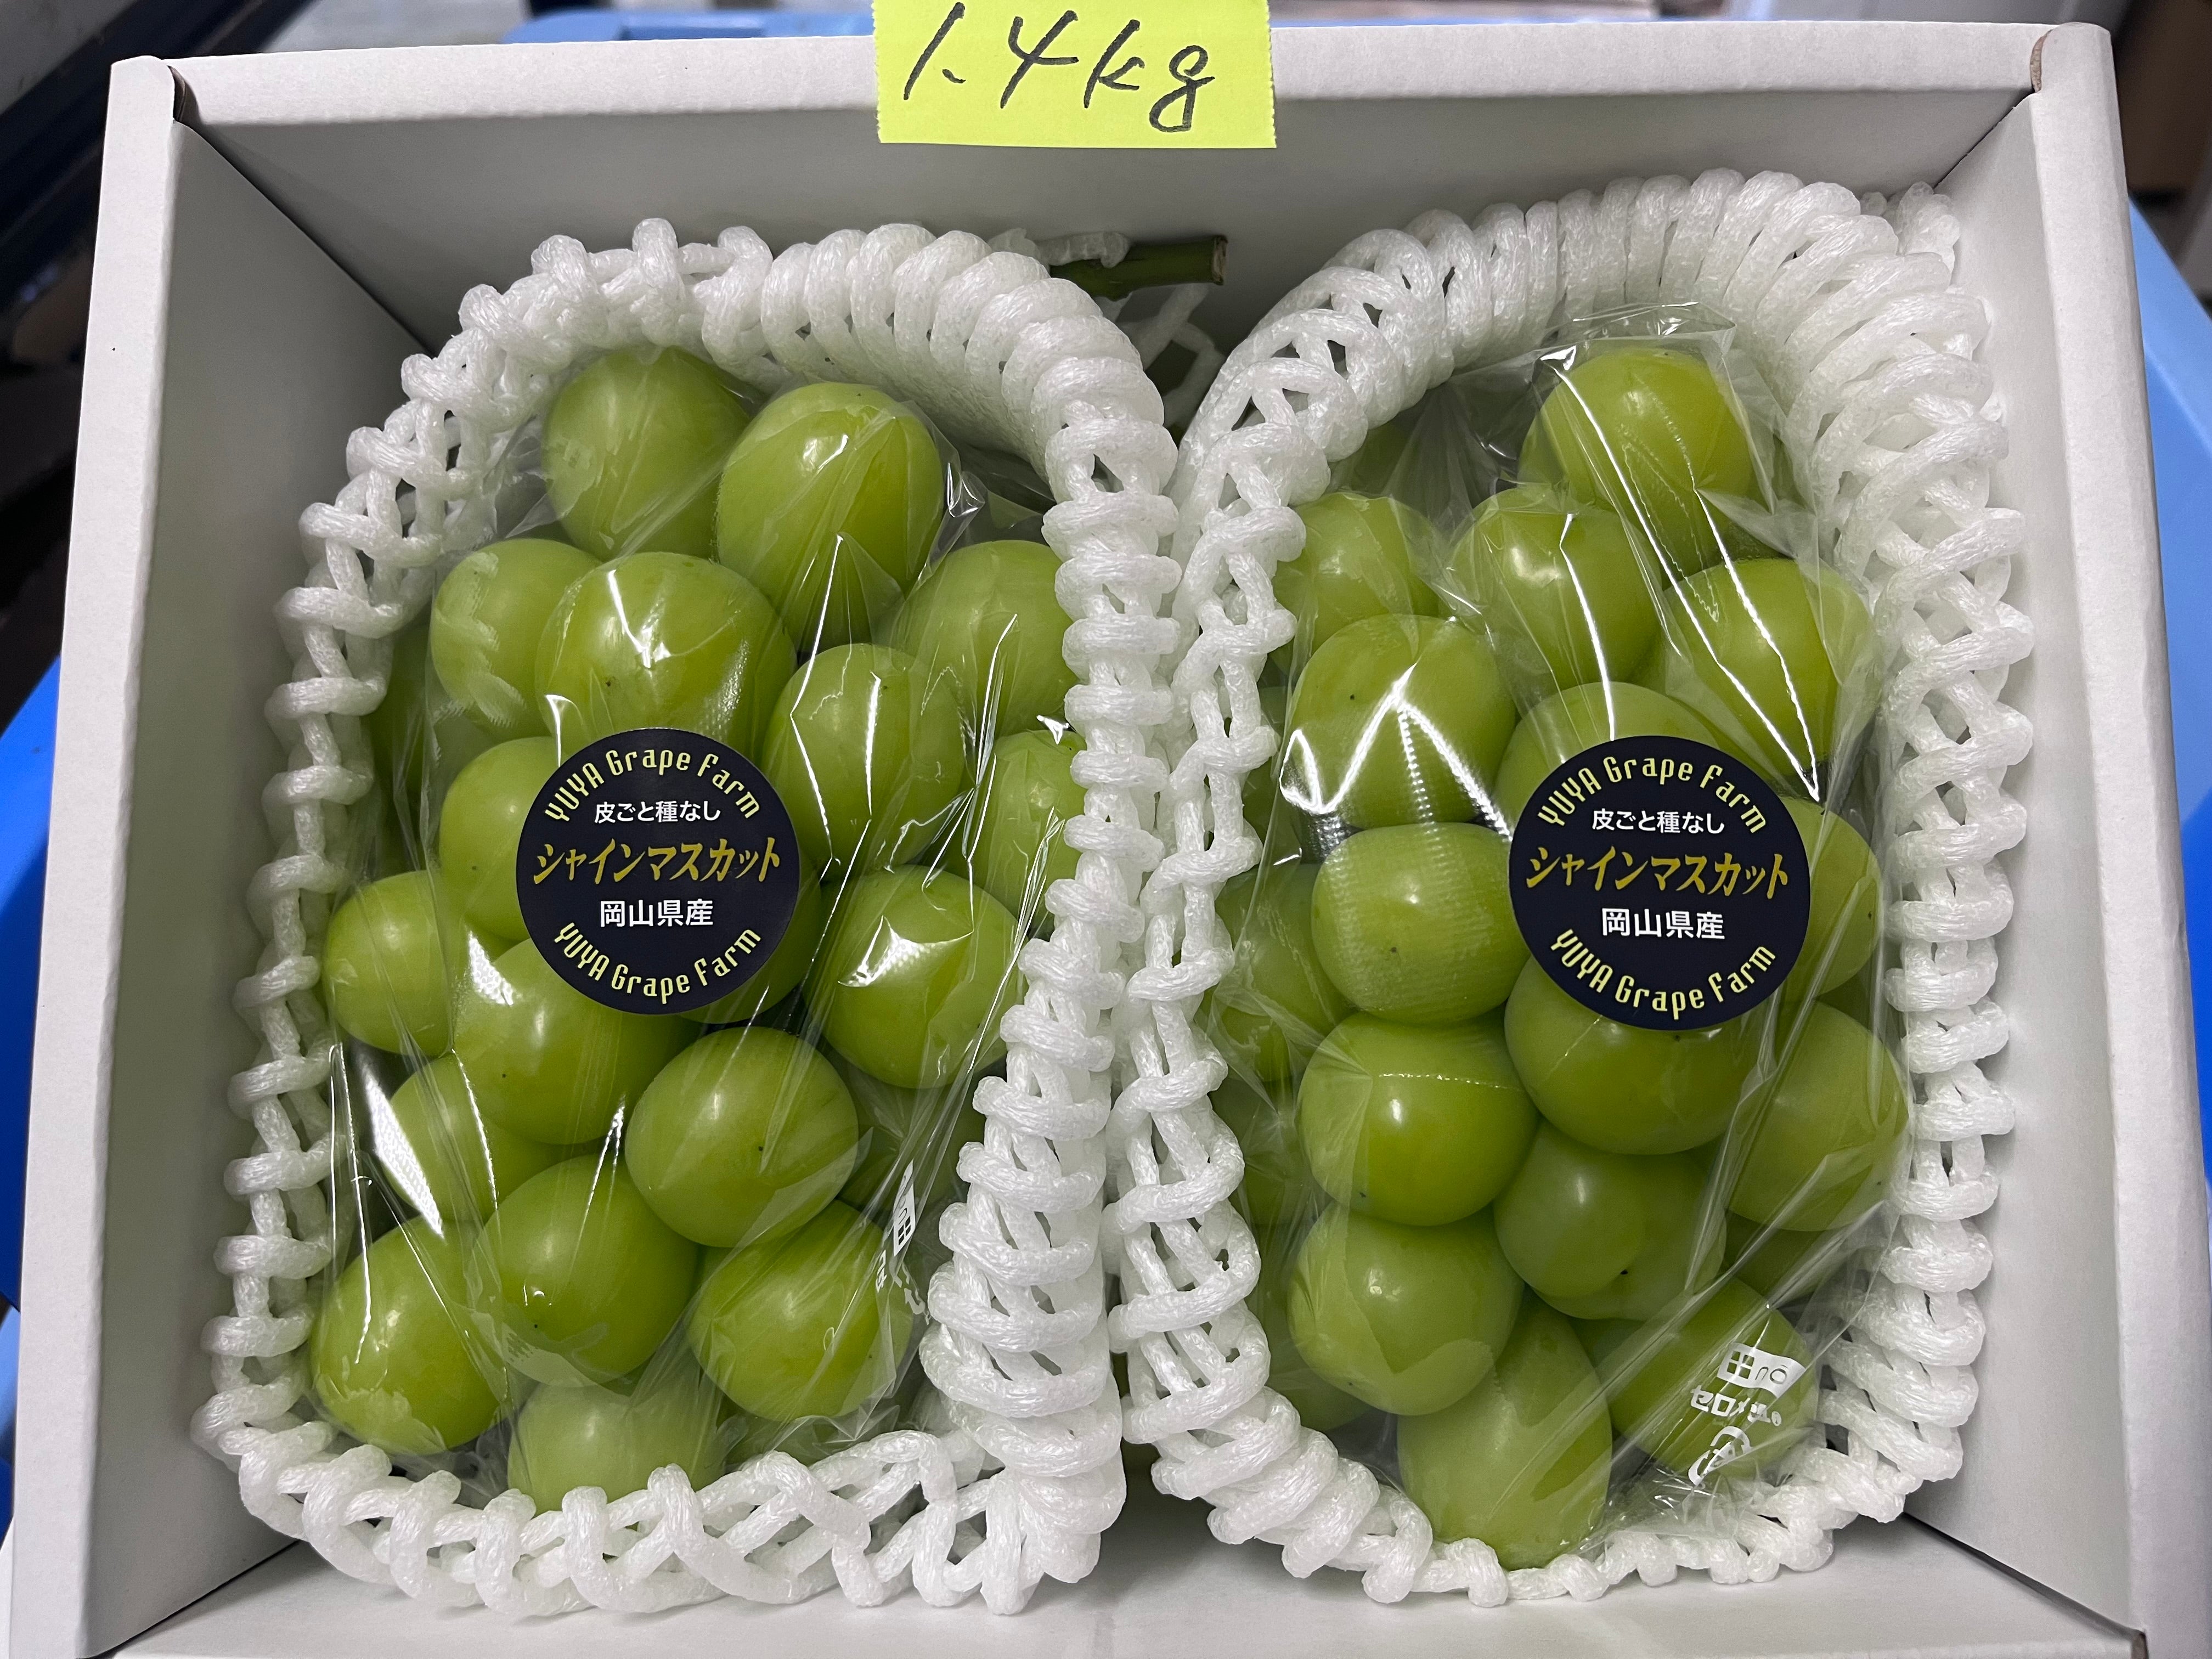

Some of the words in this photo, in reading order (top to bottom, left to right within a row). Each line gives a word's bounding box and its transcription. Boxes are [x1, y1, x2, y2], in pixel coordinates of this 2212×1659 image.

[902, 2, 1215, 132] 1.4kg
[545, 763, 605, 822] YUYA
[606, 749, 691, 776] Grape
[697, 753, 760, 819] Farm
[594, 800, 721, 823] 皮ごと種なし
[1538, 767, 1602, 826] YUYA
[1603, 756, 1693, 785] Grape
[1700, 764, 1767, 833] Farm
[1592, 809, 1725, 834] 皮ごと種なし
[533, 837, 780, 884] シャインマスカット
[1526, 845, 1788, 899] シャインマスカット
[600, 899, 713, 927] 岡山県産
[1601, 907, 1725, 939] 岡山県産
[554, 922, 610, 981] YUYA
[611, 963, 690, 1004] Grape
[694, 928, 761, 986] Farm
[1550, 929, 1613, 993] YUYA
[1615, 974, 1705, 1020] Grape
[1708, 945, 1776, 1002] Farm
